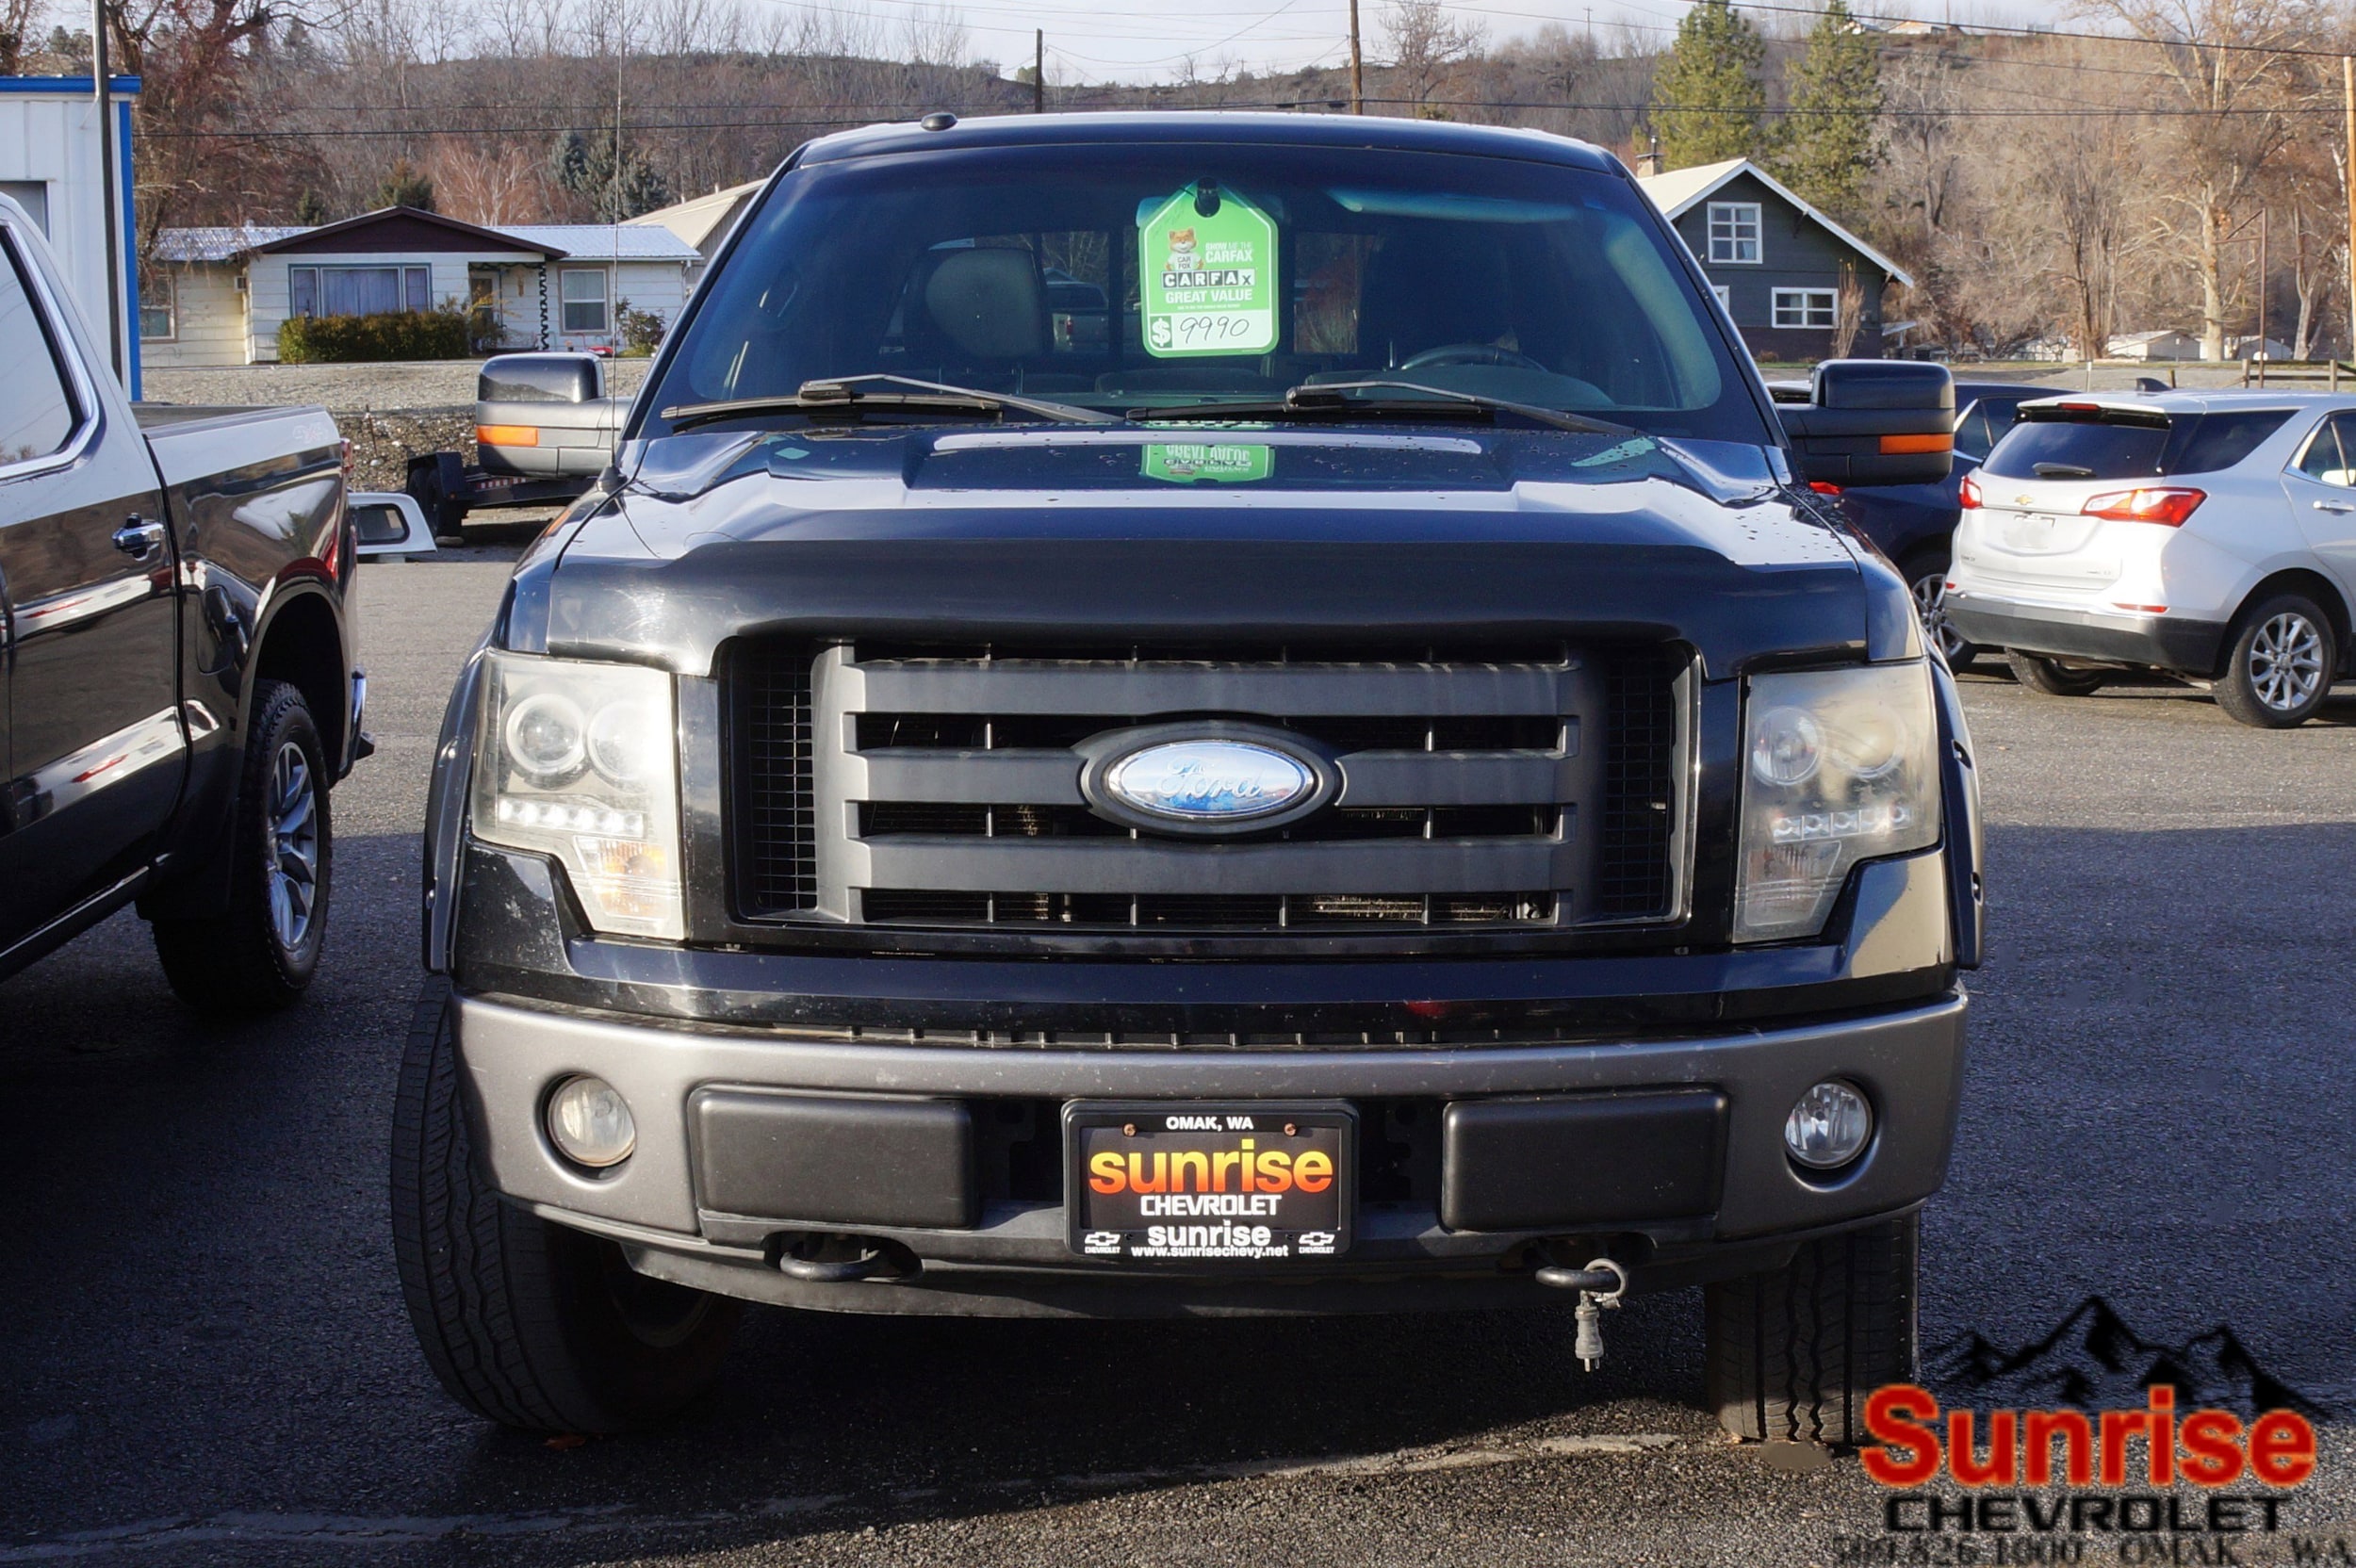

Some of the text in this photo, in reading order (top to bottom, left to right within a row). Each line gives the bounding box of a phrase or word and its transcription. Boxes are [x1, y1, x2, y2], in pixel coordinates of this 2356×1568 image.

[1205, 250, 1253, 263] CARFAX
[1162, 270, 1254, 287] CARFAX
[1165, 288, 1252, 303] GREAT VALUE
[1180, 317, 1250, 344] 9990
[1156, 758, 1263, 799] Ford
[1166, 1116, 1254, 1132] OMAK, WA
[1089, 1138, 1333, 1194] sunrise
[1140, 1194, 1282, 1216] CHEVROLET
[1148, 1219, 1271, 1247] sunrise
[1131, 1245, 1288, 1259] www.sunrisechevy.net
